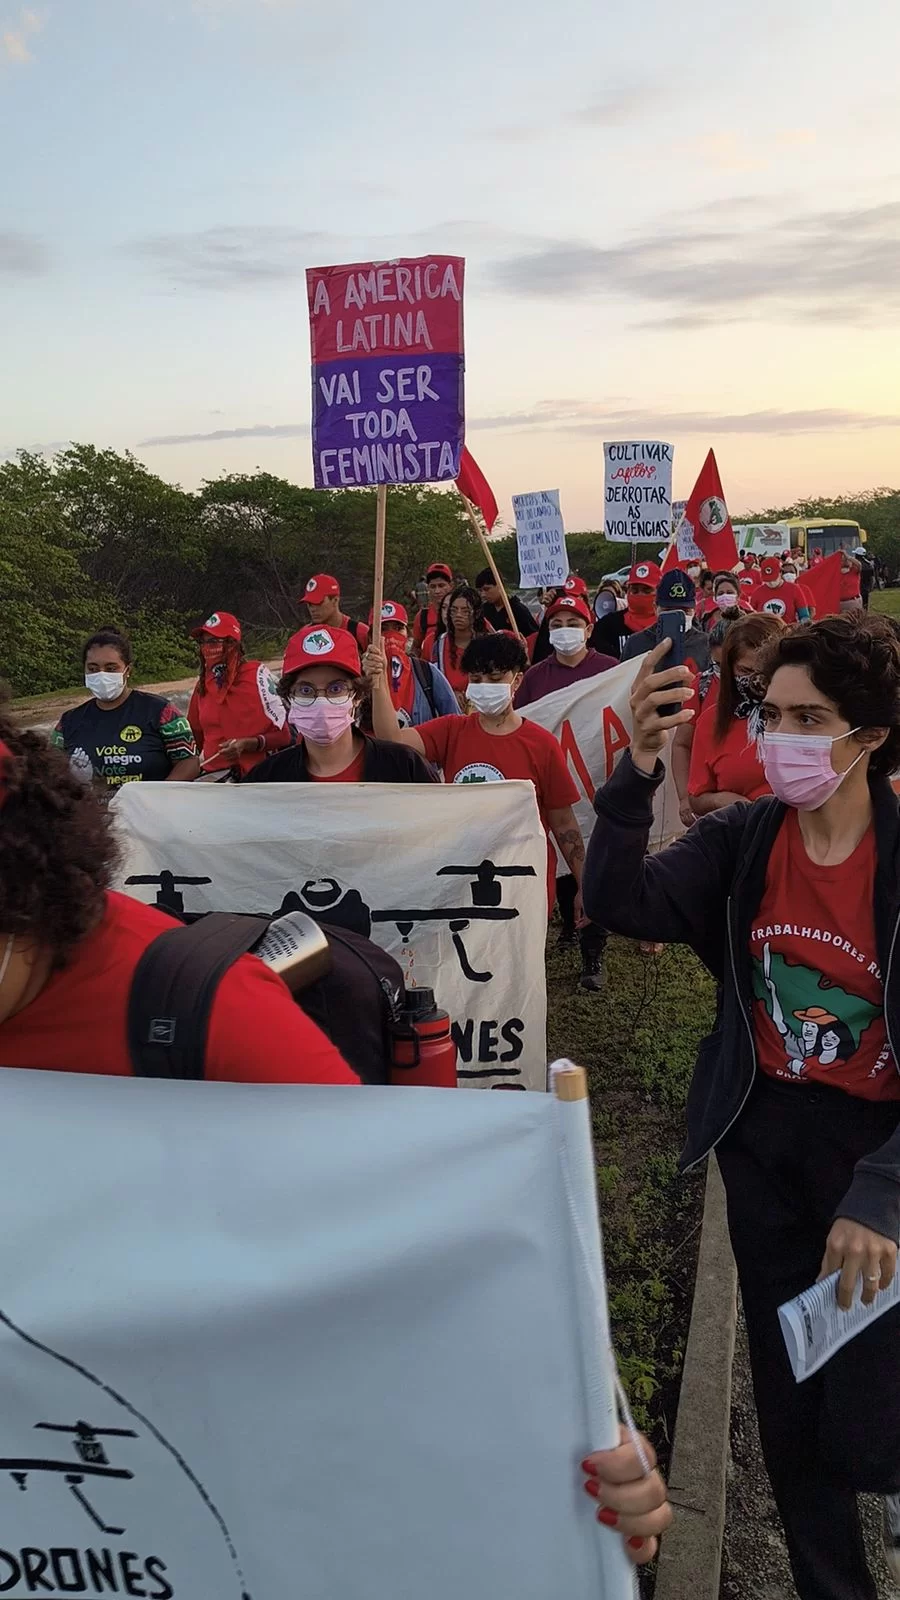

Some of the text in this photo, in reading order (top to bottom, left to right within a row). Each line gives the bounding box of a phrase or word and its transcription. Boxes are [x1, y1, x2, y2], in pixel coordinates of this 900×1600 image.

[313, 263, 462, 316] A AMERICA
[336, 310, 434, 353] LATINA
[319, 366, 440, 407] VAI SER
[345, 408, 418, 442] TODA
[319, 441, 458, 486] FEMINISTA
[608, 444, 672, 462] CULTIVAR
[605, 486, 671, 506] DERROTAR
[627, 505, 641, 519] AS
[95, 745, 127, 757] Vote
[104, 754, 142, 766] negro
[95, 764, 127, 777] Vote
[751, 924, 866, 963] TRABALHADORES
[0, 1547, 174, 1600] DRONES
